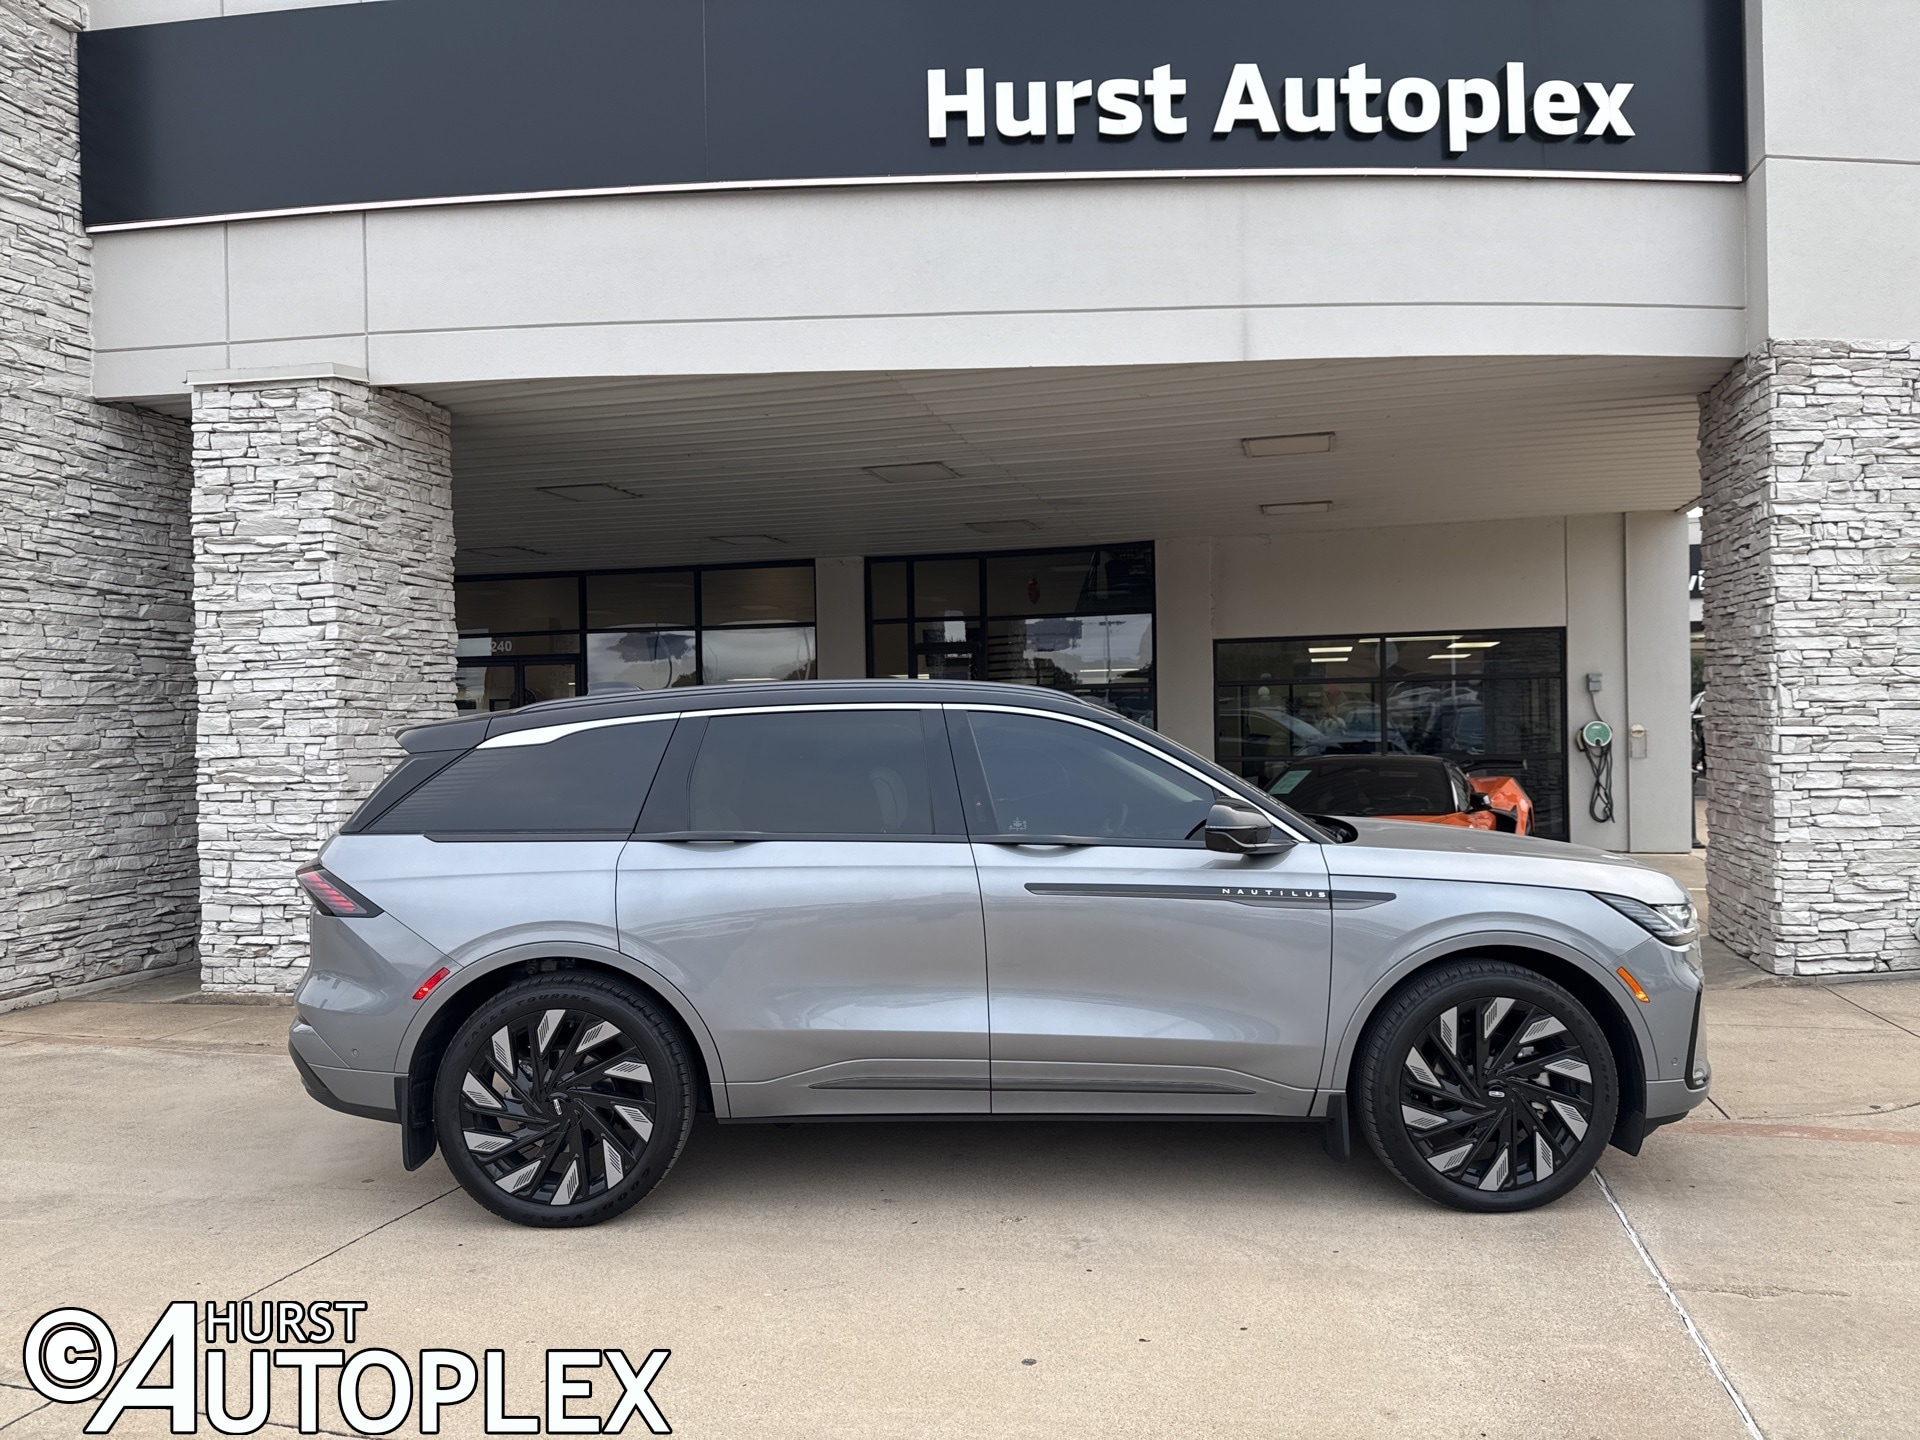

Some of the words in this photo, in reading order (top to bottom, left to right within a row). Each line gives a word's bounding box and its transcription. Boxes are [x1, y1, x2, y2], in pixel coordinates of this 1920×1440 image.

[928, 64, 1187, 138] Hurst
[1213, 62, 1635, 152] Autoplex
[491, 640, 513, 653] 240
[1221, 888, 1326, 898] NAUTILUS
[464, 1007, 509, 1049] EAGLE
[516, 992, 592, 1007] TOURING
